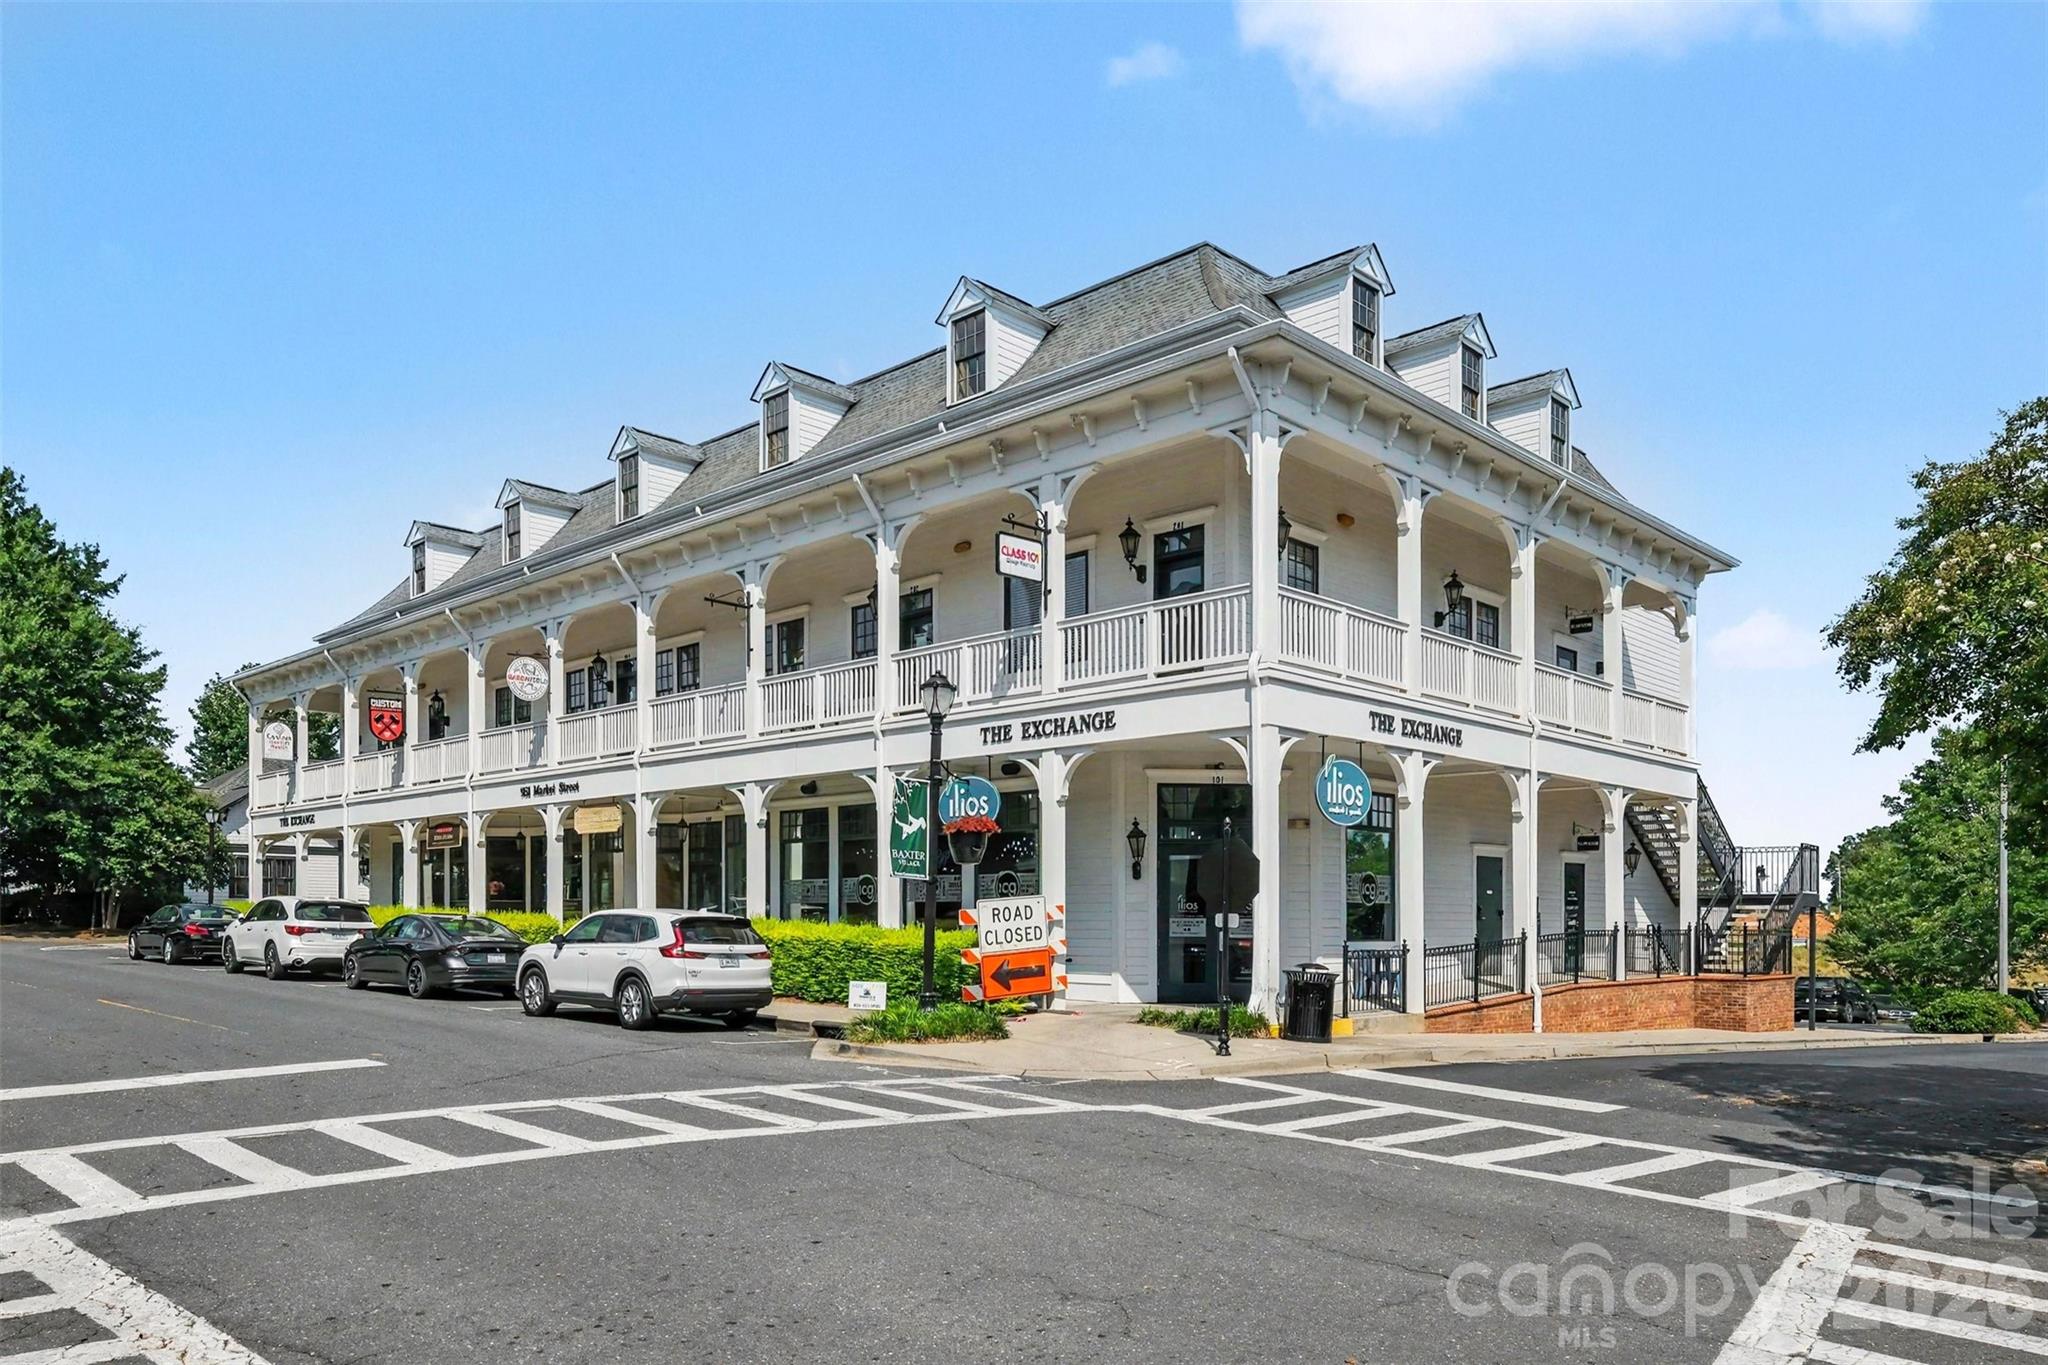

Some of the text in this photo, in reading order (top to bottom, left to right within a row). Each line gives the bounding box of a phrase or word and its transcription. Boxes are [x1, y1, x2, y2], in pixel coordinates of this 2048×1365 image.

[1001, 545, 1039, 563] CLASS 101
[370, 698, 402, 709] CUSTOM
[979, 710, 1117, 746] THE EXCHANGE
[1368, 711, 1463, 748] THE EXCHANGE
[558, 781, 580, 795] Street
[1212, 776, 1224, 784] 101
[1326, 765, 1364, 807] ilios
[948, 783, 989, 818] ilios
[891, 849, 926, 861] BAXTER
[992, 905, 1034, 924] ROAD
[984, 925, 1043, 946] CLOSED
